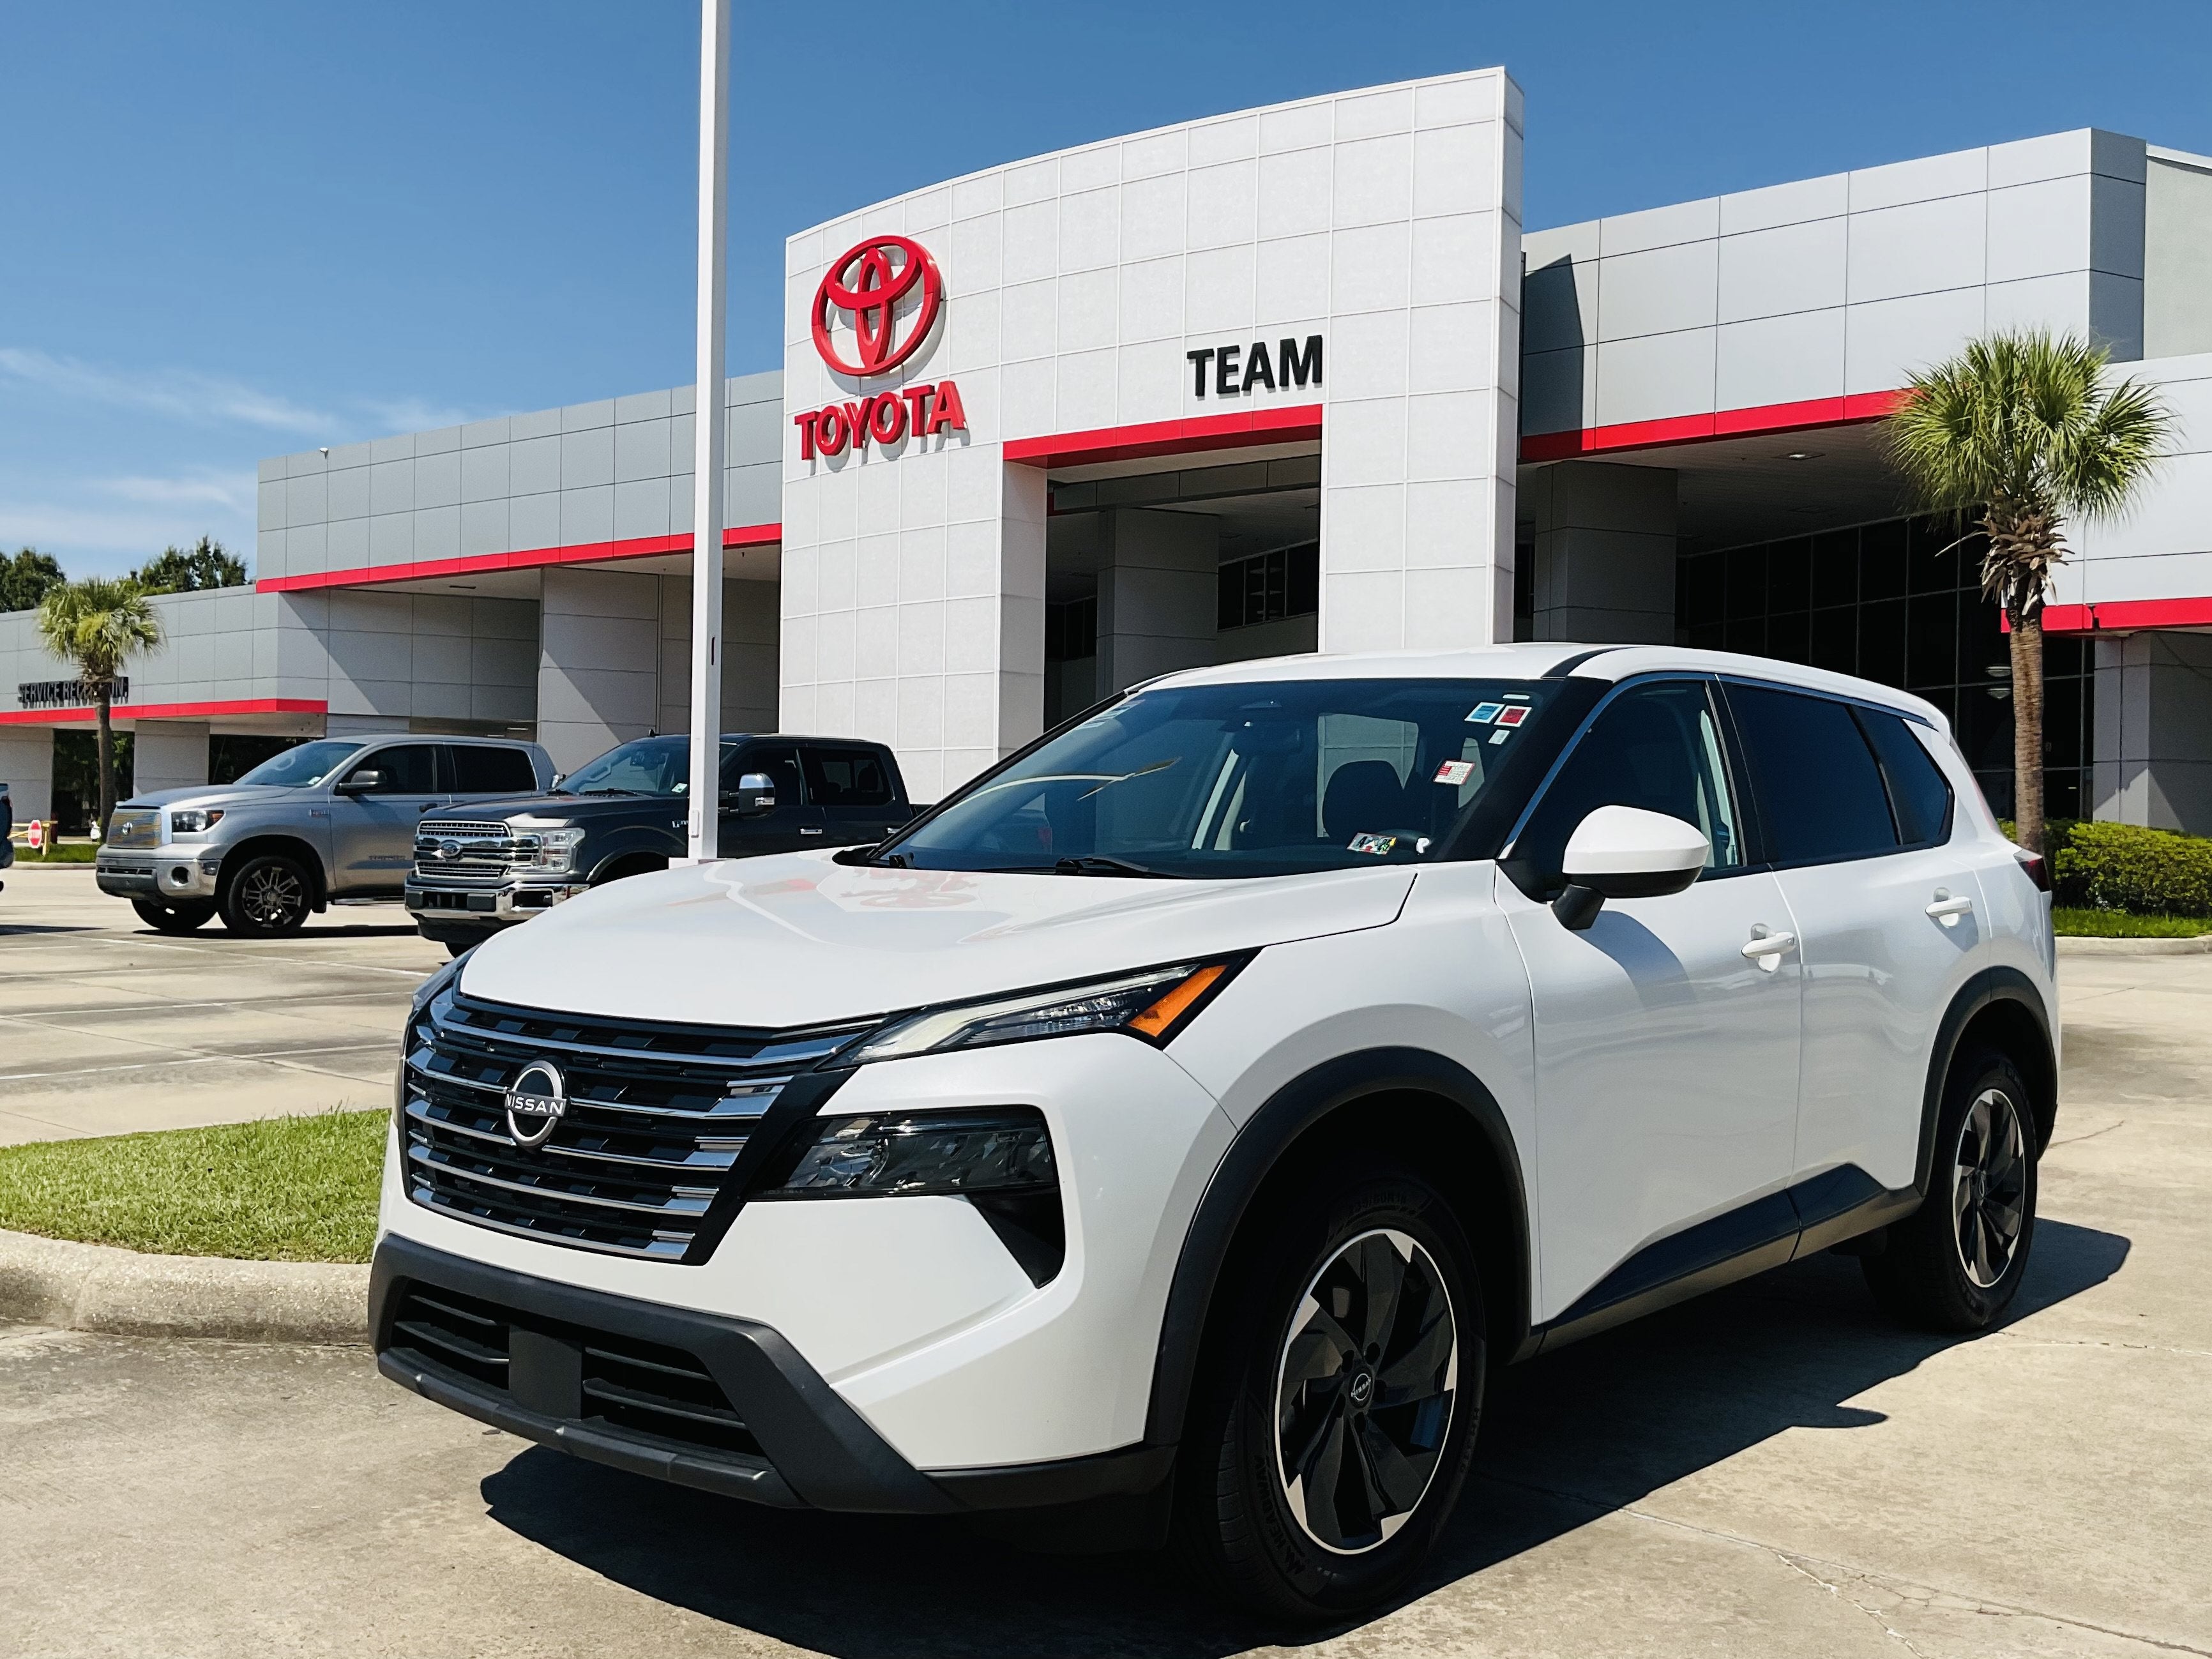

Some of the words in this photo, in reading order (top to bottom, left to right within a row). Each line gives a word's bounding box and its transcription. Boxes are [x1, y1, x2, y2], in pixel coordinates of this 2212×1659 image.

[1187, 335, 1322, 397] TEAM
[794, 381, 967, 460] TOYOTA
[18, 681, 60, 703] SERVICE
[506, 1093, 563, 1114] NISSAN
[1254, 1455, 1286, 1549] HEADWAY
